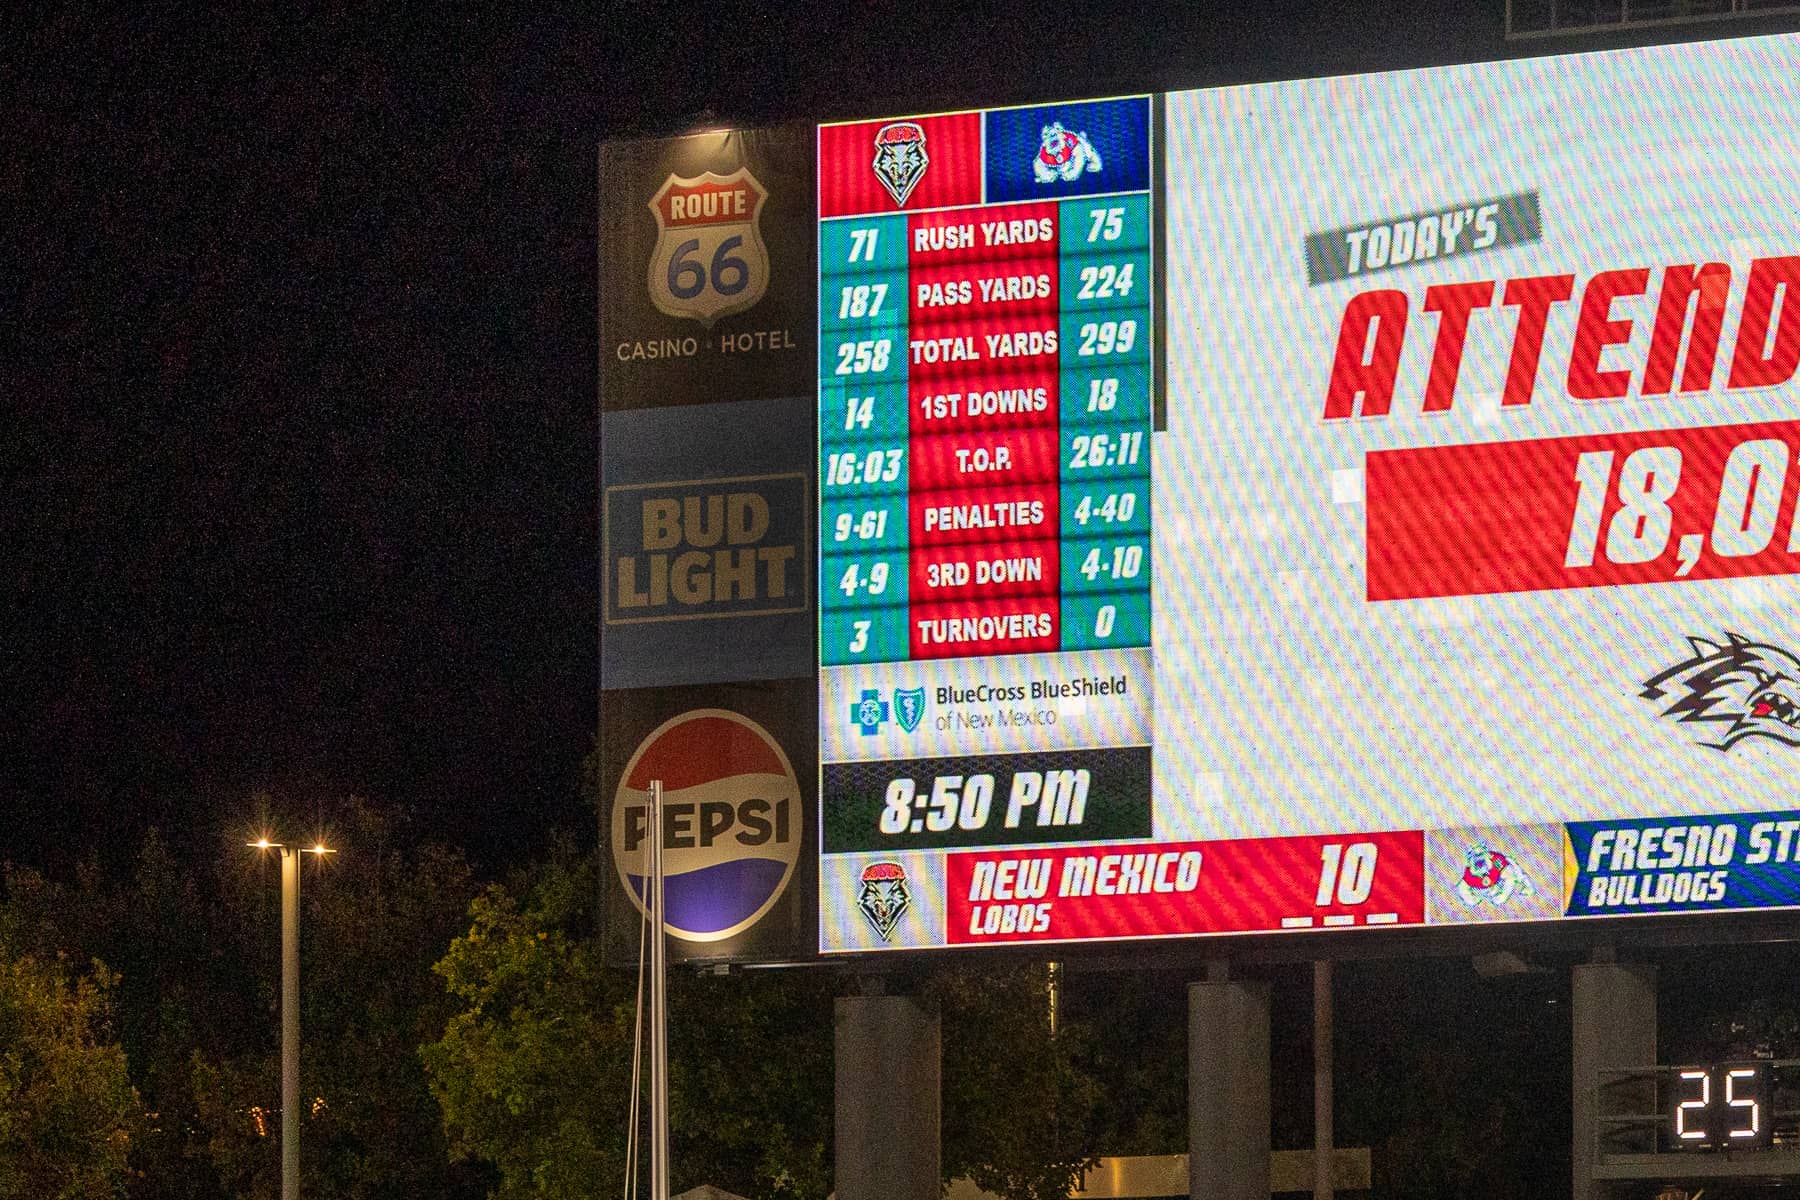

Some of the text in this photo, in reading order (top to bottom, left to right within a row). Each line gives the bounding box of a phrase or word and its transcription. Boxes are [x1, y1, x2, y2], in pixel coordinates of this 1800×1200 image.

[670, 188, 746, 218] ROUTE
[914, 217, 1054, 252] RUSH YARDS
[1087, 208, 1125, 243] 75
[1346, 202, 1500, 275] TODAY'S
[848, 229, 878, 262] 71
[667, 235, 750, 299] 66
[1076, 263, 1134, 299] 224
[839, 284, 887, 319] 187
[917, 274, 1051, 308] PASS YARDS
[617, 330, 795, 362] CASINO HOTEL
[910, 330, 1058, 365] TOTAL YARDS
[1078, 320, 1136, 355] 299
[835, 339, 891, 376] 258
[920, 390, 1048, 419] 1ST DOWNS
[1087, 378, 1119, 412] 18
[845, 397, 874, 431] 14
[956, 446, 1012, 473] T.O.P.
[1068, 431, 1143, 469] 26:11
[826, 450, 903, 486] 16:03
[641, 493, 769, 551] BUD
[924, 501, 1045, 531] PENALTIES
[617, 545, 795, 609] LIGHT
[927, 556, 1042, 588] 3RD DOWN
[850, 620, 868, 653] 3
[918, 613, 1053, 645] TURNOVERS
[1094, 605, 1117, 638] 0
[936, 675, 1127, 705] BlueCross BlueShield
[936, 706, 1057, 729] of New Mexico
[879, 768, 1091, 835] 8:50 PM
[623, 797, 790, 852] PEPSI
[1587, 825, 1740, 873] FRESNO
[969, 851, 1203, 902] NEW MEXICO
[1314, 842, 1378, 908] 10
[1587, 869, 1727, 908] BULLDOGS
[969, 903, 1051, 935] LOBOS
[1676, 1069, 1759, 1139] 25
